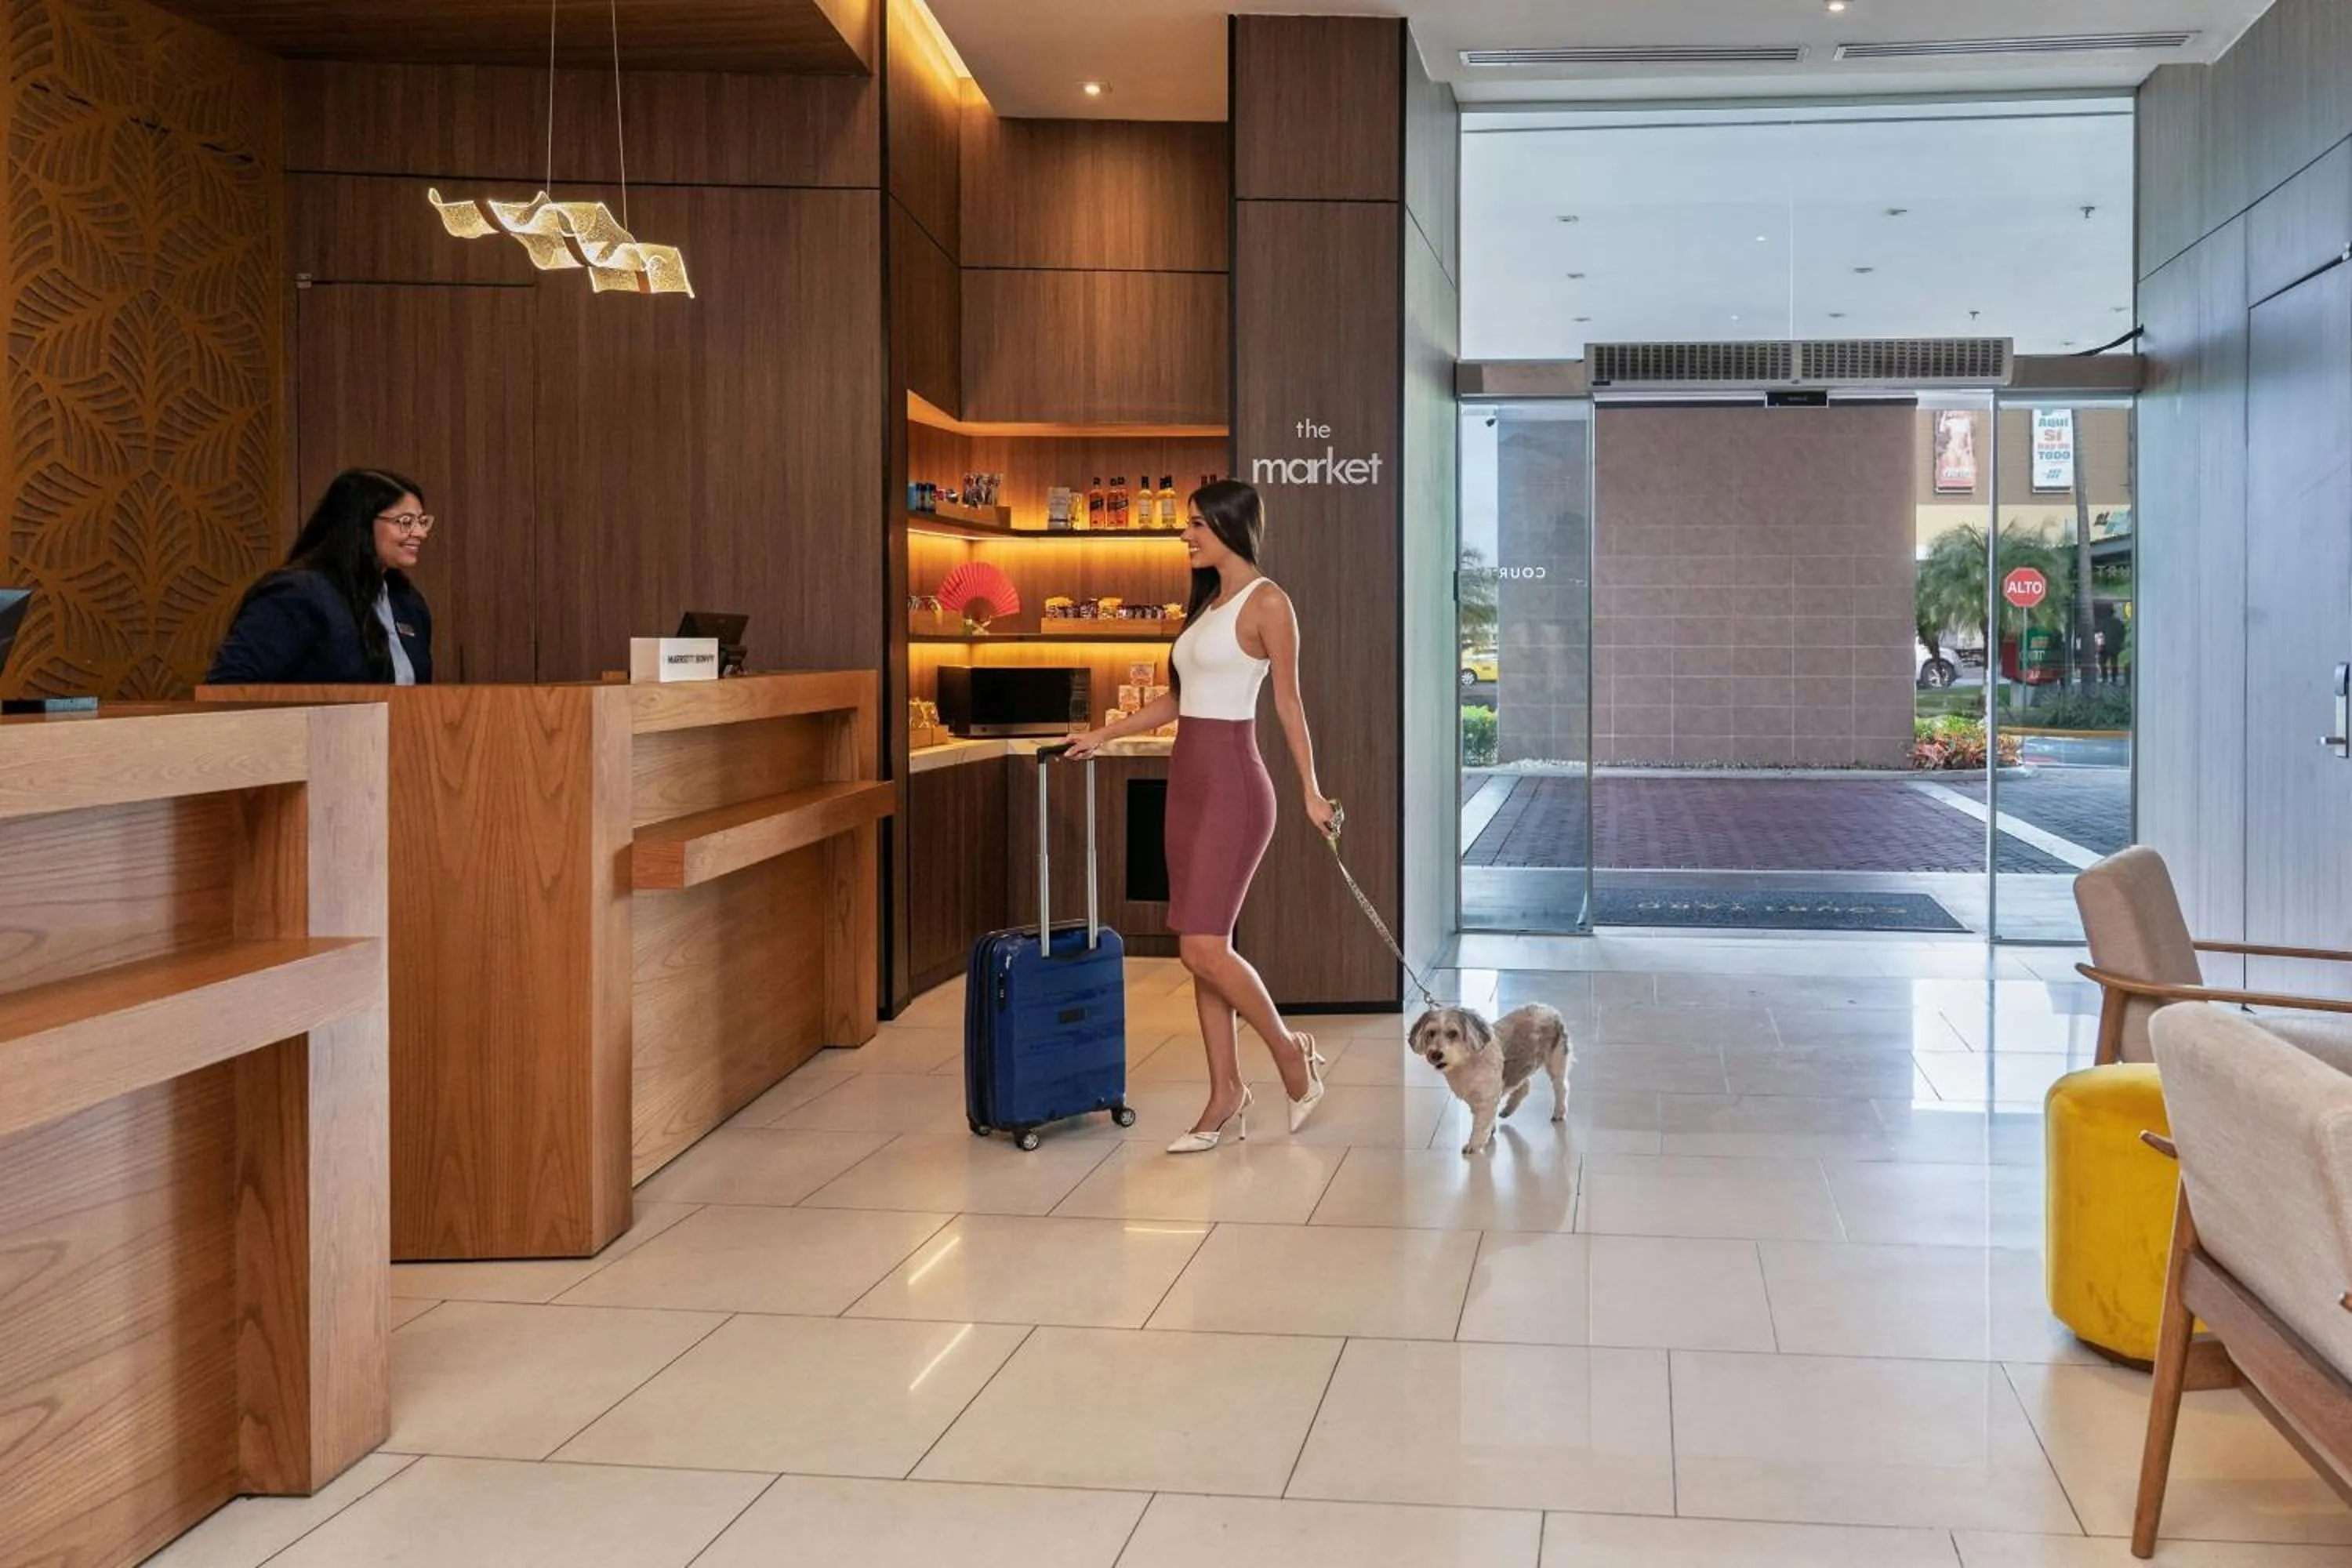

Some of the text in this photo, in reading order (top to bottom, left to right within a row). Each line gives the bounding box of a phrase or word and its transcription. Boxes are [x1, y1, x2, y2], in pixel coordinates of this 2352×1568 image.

[1296, 419, 1331, 438] the
[2038, 451, 2071, 460] TODO
[1252, 445, 1384, 485] market
[2006, 580, 2043, 595] ALTO
